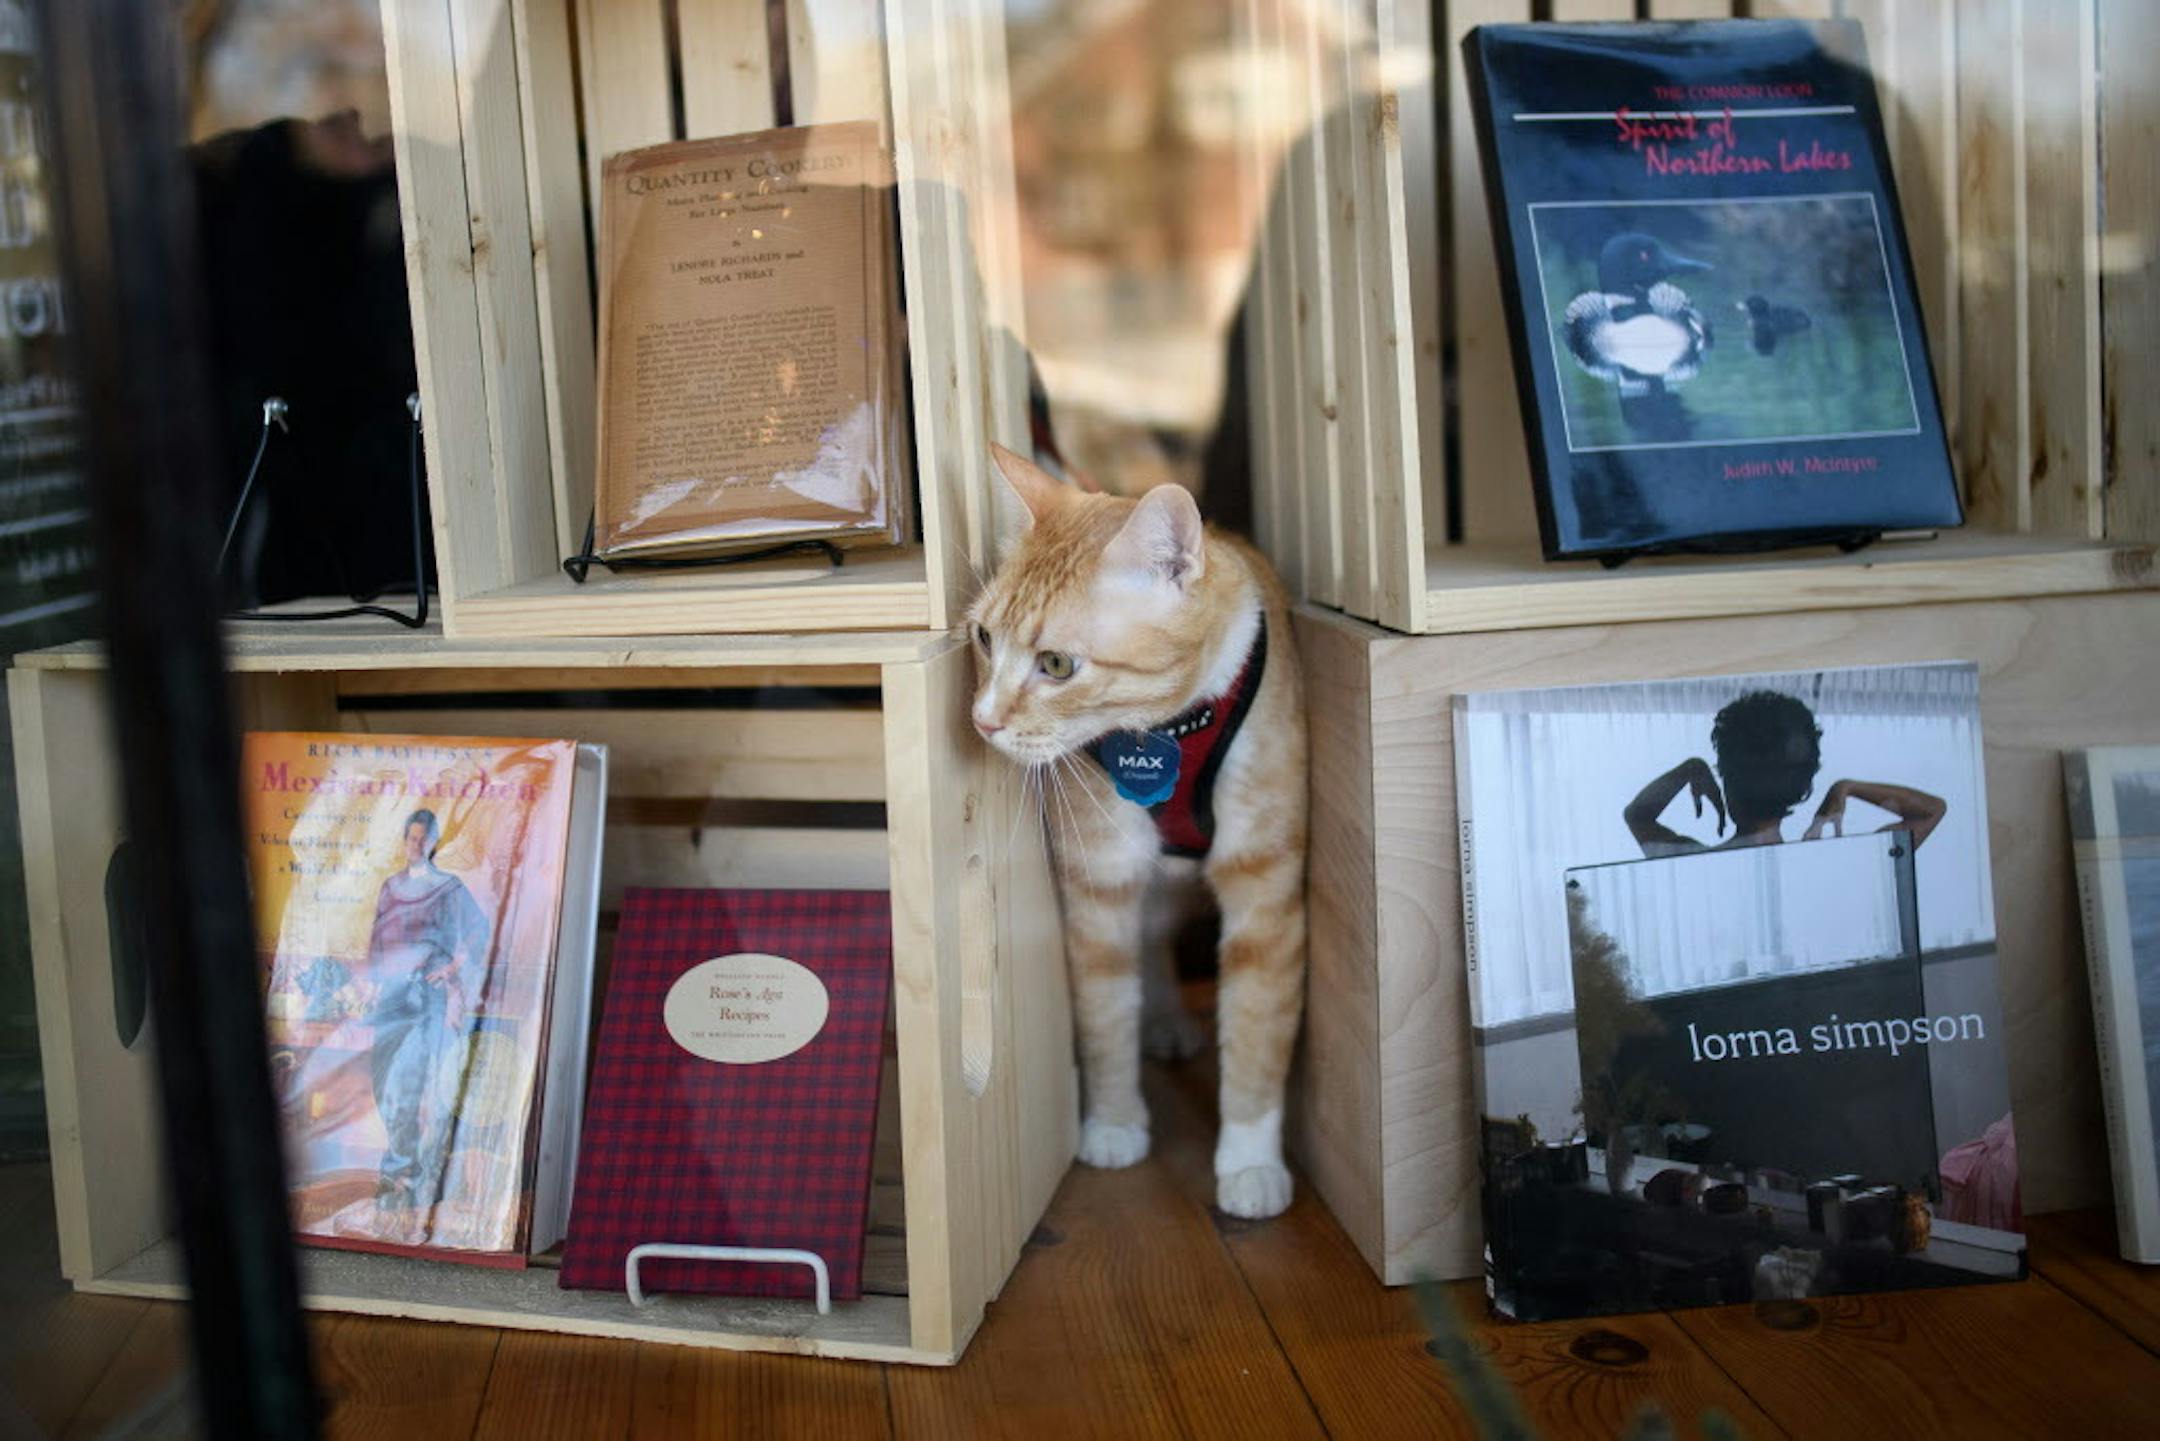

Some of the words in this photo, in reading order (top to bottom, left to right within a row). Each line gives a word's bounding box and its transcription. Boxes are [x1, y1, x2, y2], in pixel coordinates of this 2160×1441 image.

[1687, 84, 1762, 99] COMMON
[1615, 105, 1699, 150] Spirit
[1707, 106, 1736, 150] of
[1646, 142, 1772, 176] Northern
[1779, 138, 1852, 173] Lakes
[720, 252, 782, 266] RICHARDS
[737, 267, 775, 281] TREAT
[1724, 461, 1773, 480] Judith
[1804, 455, 1879, 474] McIntyre
[308, 744, 362, 758] RICK
[1119, 756, 1164, 769] MAX
[260, 761, 395, 795] Mexican
[406, 765, 538, 800] Kitchen
[1462, 820, 1473, 875] lorna
[1465, 881, 1478, 972] simpson
[709, 985, 752, 1000] Rose's
[719, 1007, 770, 1024] Recipes
[1686, 1022, 1802, 1062] lorna
[1810, 1013, 1985, 1056] simpson
